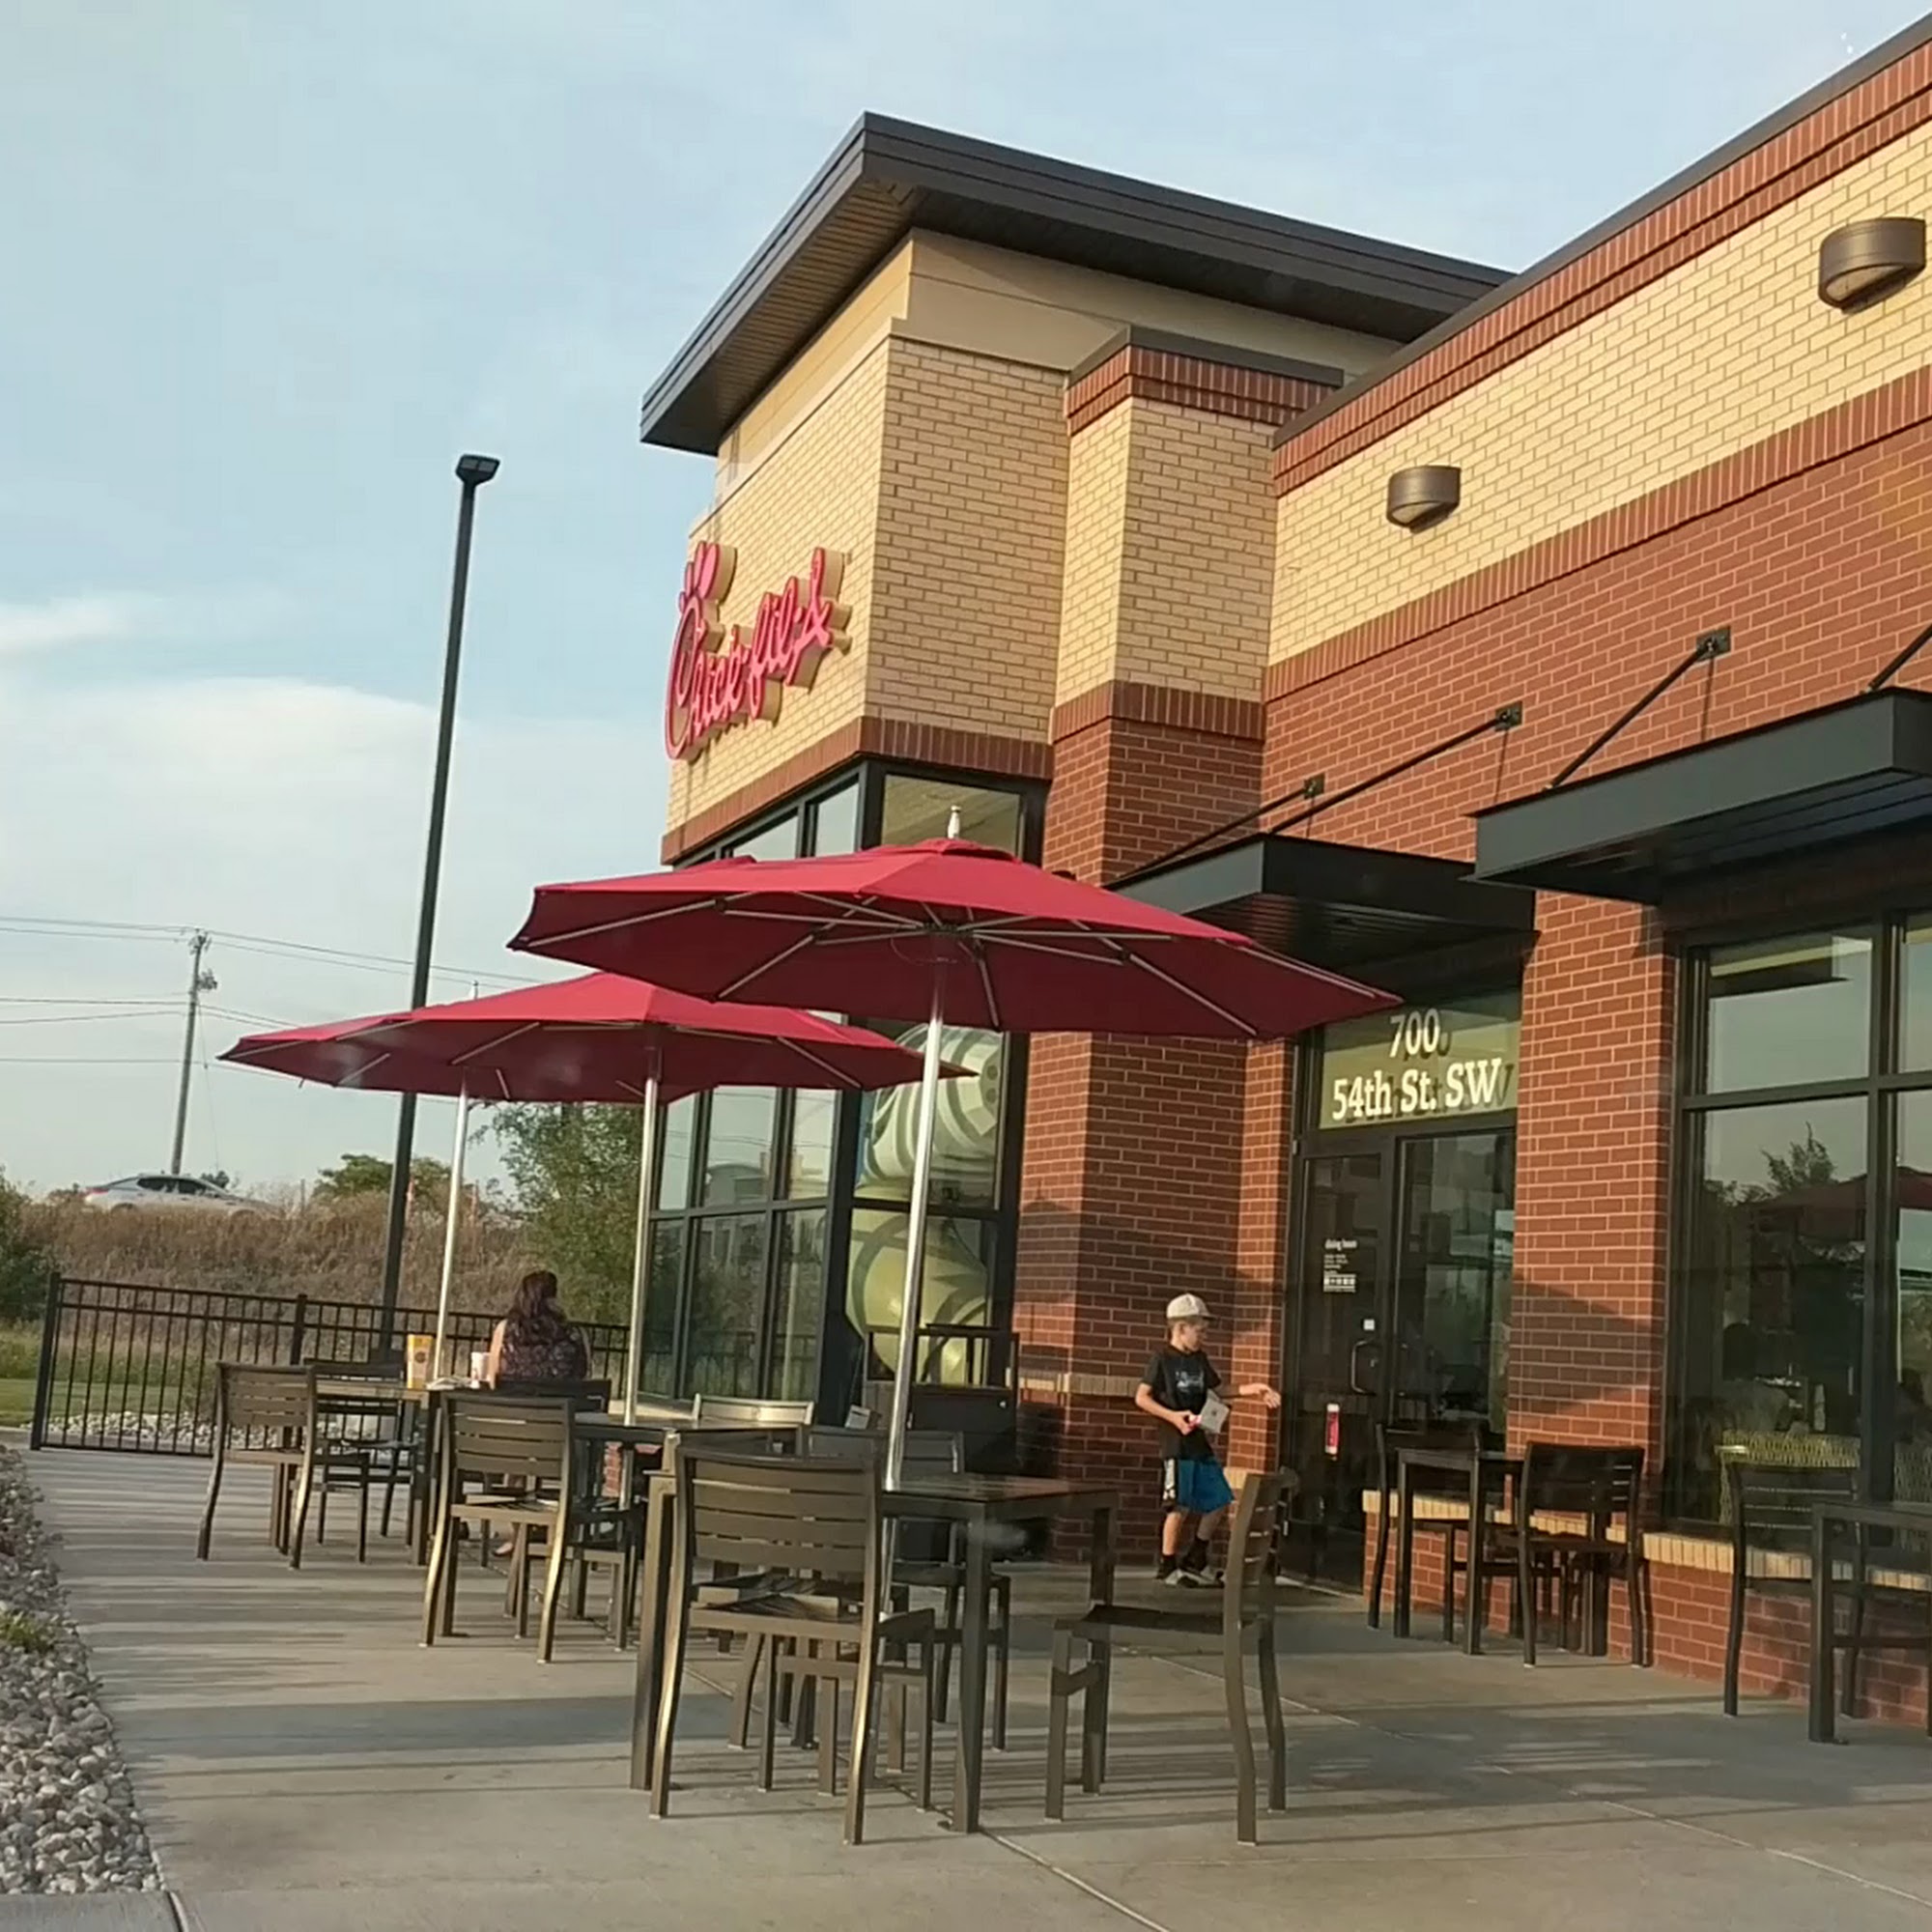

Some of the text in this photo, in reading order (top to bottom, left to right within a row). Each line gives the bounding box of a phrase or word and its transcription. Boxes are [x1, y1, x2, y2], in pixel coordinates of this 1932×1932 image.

[665, 541, 834, 760] Chick-fil-A
[1389, 1008, 1440, 1058] 700
[1332, 1058, 1502, 1121] 54th St. SW
